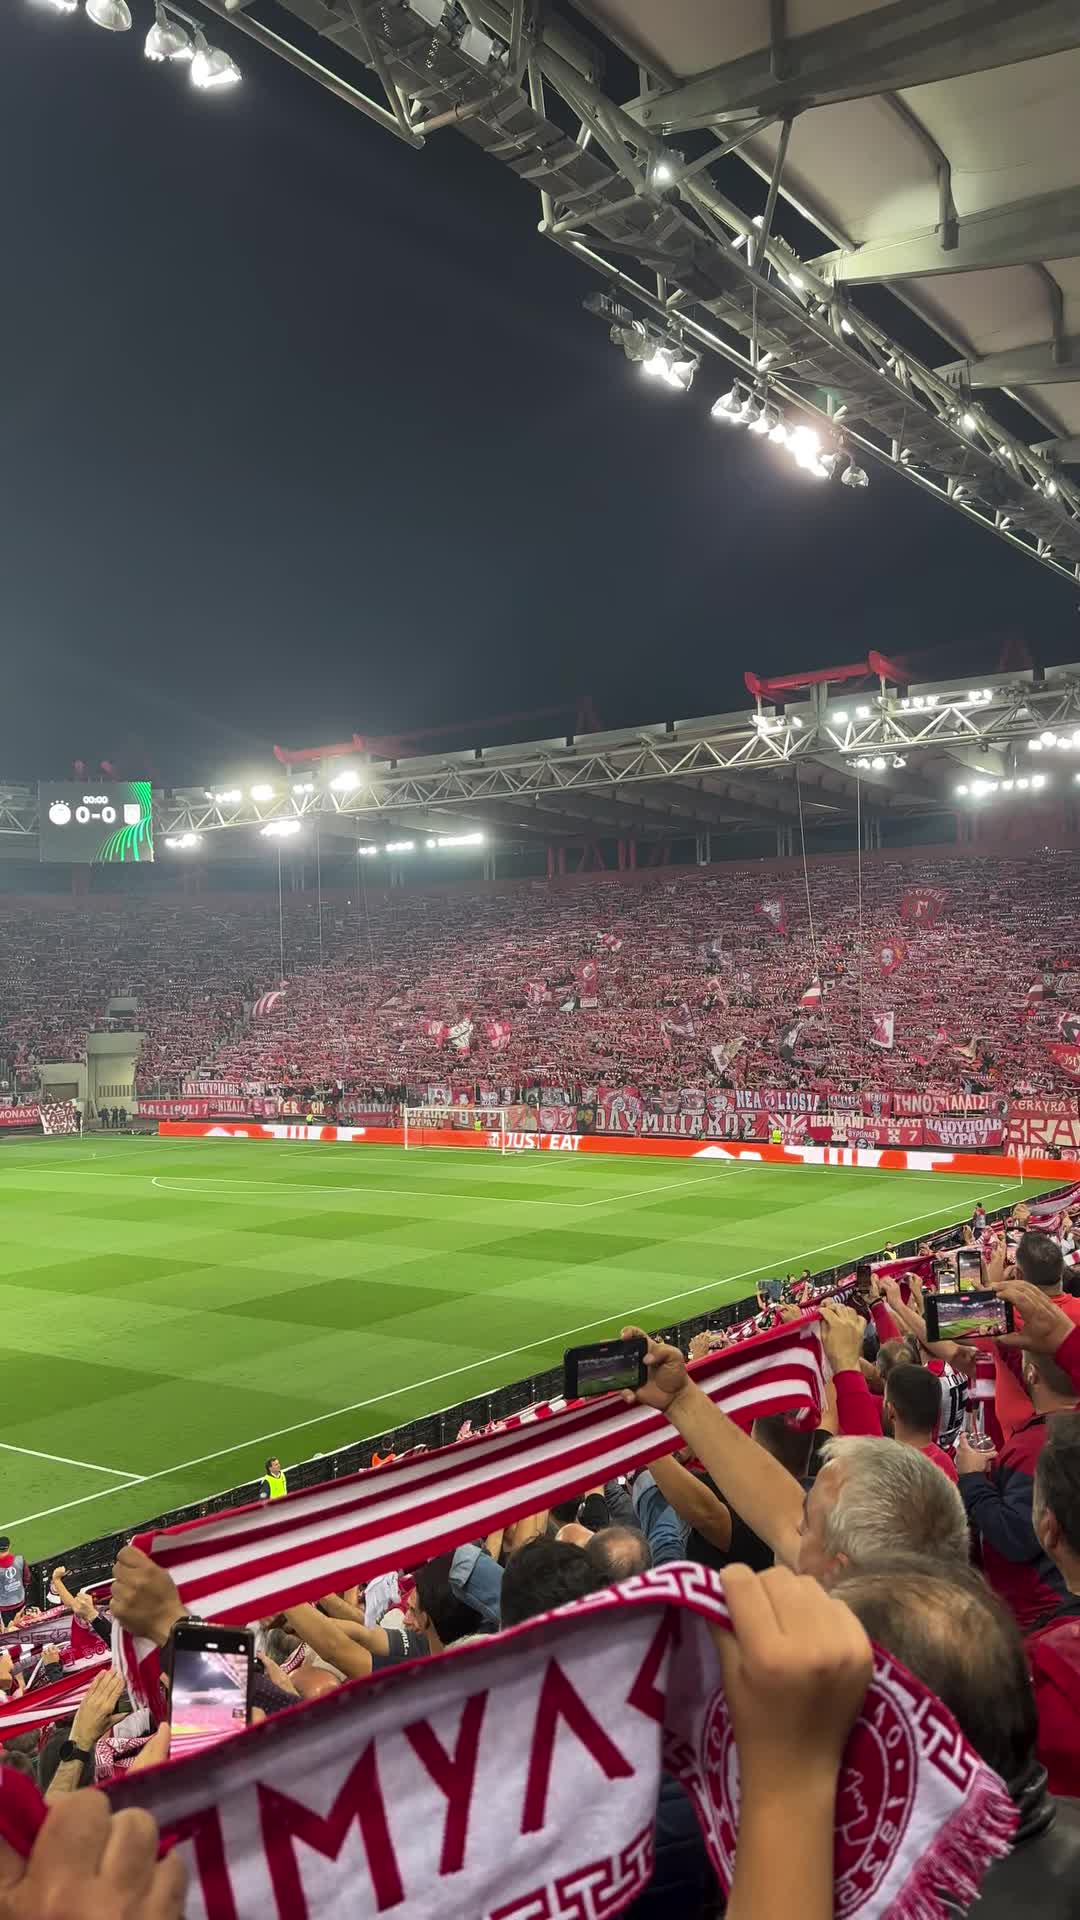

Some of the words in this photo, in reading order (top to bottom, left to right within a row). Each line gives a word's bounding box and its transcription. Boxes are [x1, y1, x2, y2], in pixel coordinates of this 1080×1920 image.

[83, 796, 108, 804] 00:00
[76, 806, 116, 823] 0-0
[736, 1091, 762, 1109] NEA
[140, 1103, 199, 1115] KALLIPOLI
[202, 1103, 208, 1114] 7
[505, 1132, 545, 1150] JUST
[549, 1134, 583, 1151] EAT
